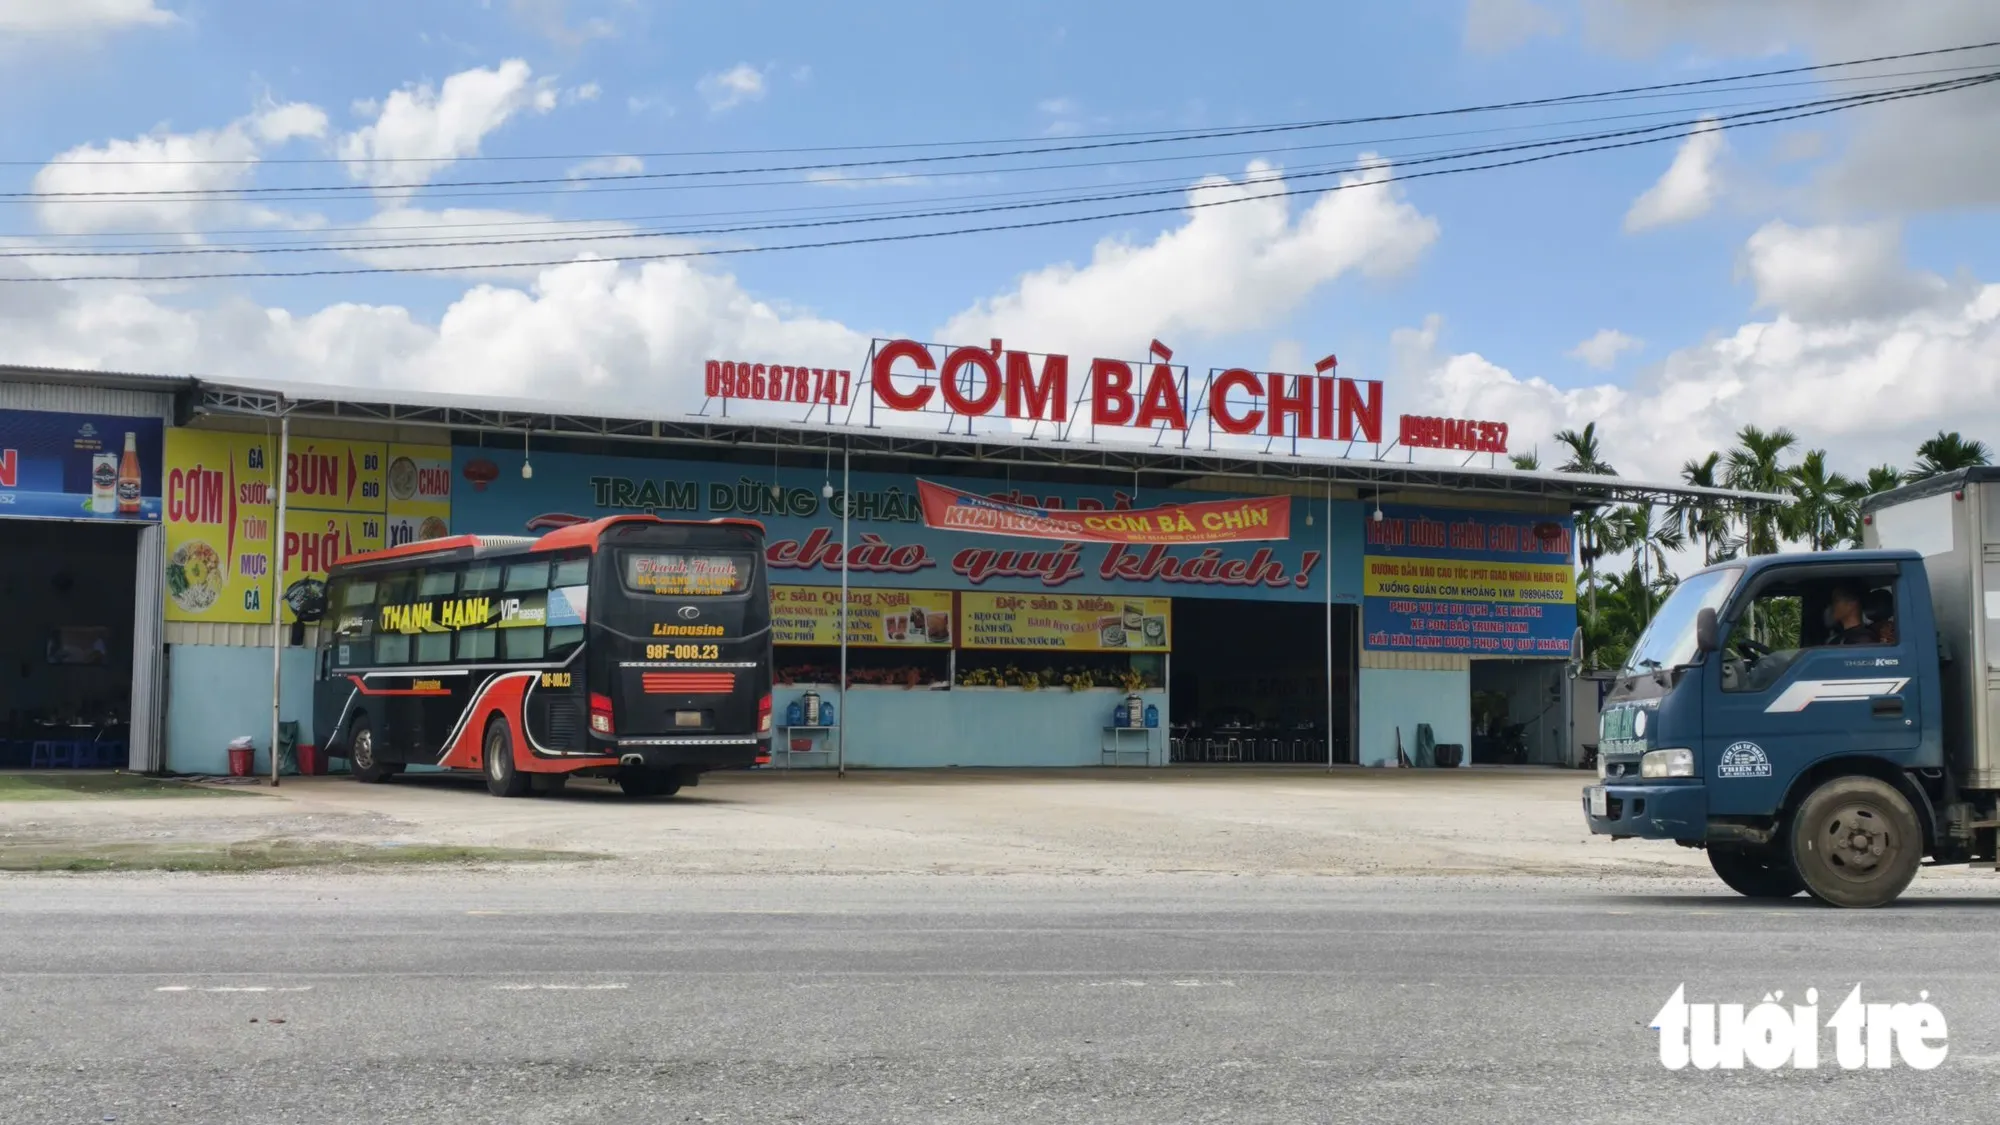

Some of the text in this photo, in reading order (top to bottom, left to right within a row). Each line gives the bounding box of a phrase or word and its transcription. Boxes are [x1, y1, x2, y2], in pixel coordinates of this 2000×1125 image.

[705, 360, 850, 406] 0986878747
[873, 338, 1382, 443] CƠM BÀ CHÍN
[248, 445, 264, 469] GÀ
[286, 445, 338, 496] BÚN
[418, 464, 450, 496] CHÁO
[168, 464, 223, 523] CƠM
[591, 475, 923, 522] TRẠM DỪNG CHÂN
[243, 516, 267, 540] TÔM
[363, 519, 378, 538] TÁI
[944, 506, 997, 527] KHAI
[1085, 514, 1151, 532] CƠM
[1157, 509, 1196, 532] BÀ
[1202, 505, 1268, 531] CHÍN
[283, 519, 340, 573] PHỞ
[390, 521, 414, 548] XÔI
[1408, 515, 1445, 548] DỪNG
[1450, 517, 1486, 550] CHÂN
[1490, 523, 1518, 552] CƠM
[240, 553, 267, 579] MỰC
[766, 527, 936, 572] chào
[952, 543, 1085, 586] quý
[1420, 564, 1435, 577] VÀO
[1437, 566, 1453, 579] CAO
[244, 586, 260, 612] CÁ
[790, 588, 817, 602] sản
[1379, 580, 1409, 594] XUỐNG
[1439, 585, 1459, 596] CƠM
[1461, 583, 1496, 598] KHOẢNG
[1499, 588, 1515, 598] 1KM
[383, 597, 490, 630] THANH HẠNH
[500, 598, 519, 621] VIP
[1390, 600, 1419, 615] PHỤC
[1420, 602, 1434, 617] VỤ
[1436, 602, 1448, 614] XE
[1496, 605, 1509, 616] XE
[1511, 603, 1543, 618] KHÁCH
[653, 624, 724, 637] Limousine
[1411, 618, 1424, 630] XE
[1472, 621, 1503, 632] TRUNG
[1505, 622, 1529, 633] NAM
[646, 644, 719, 660] 98F-008.23
[1537, 636, 1569, 650] KHÁCH
